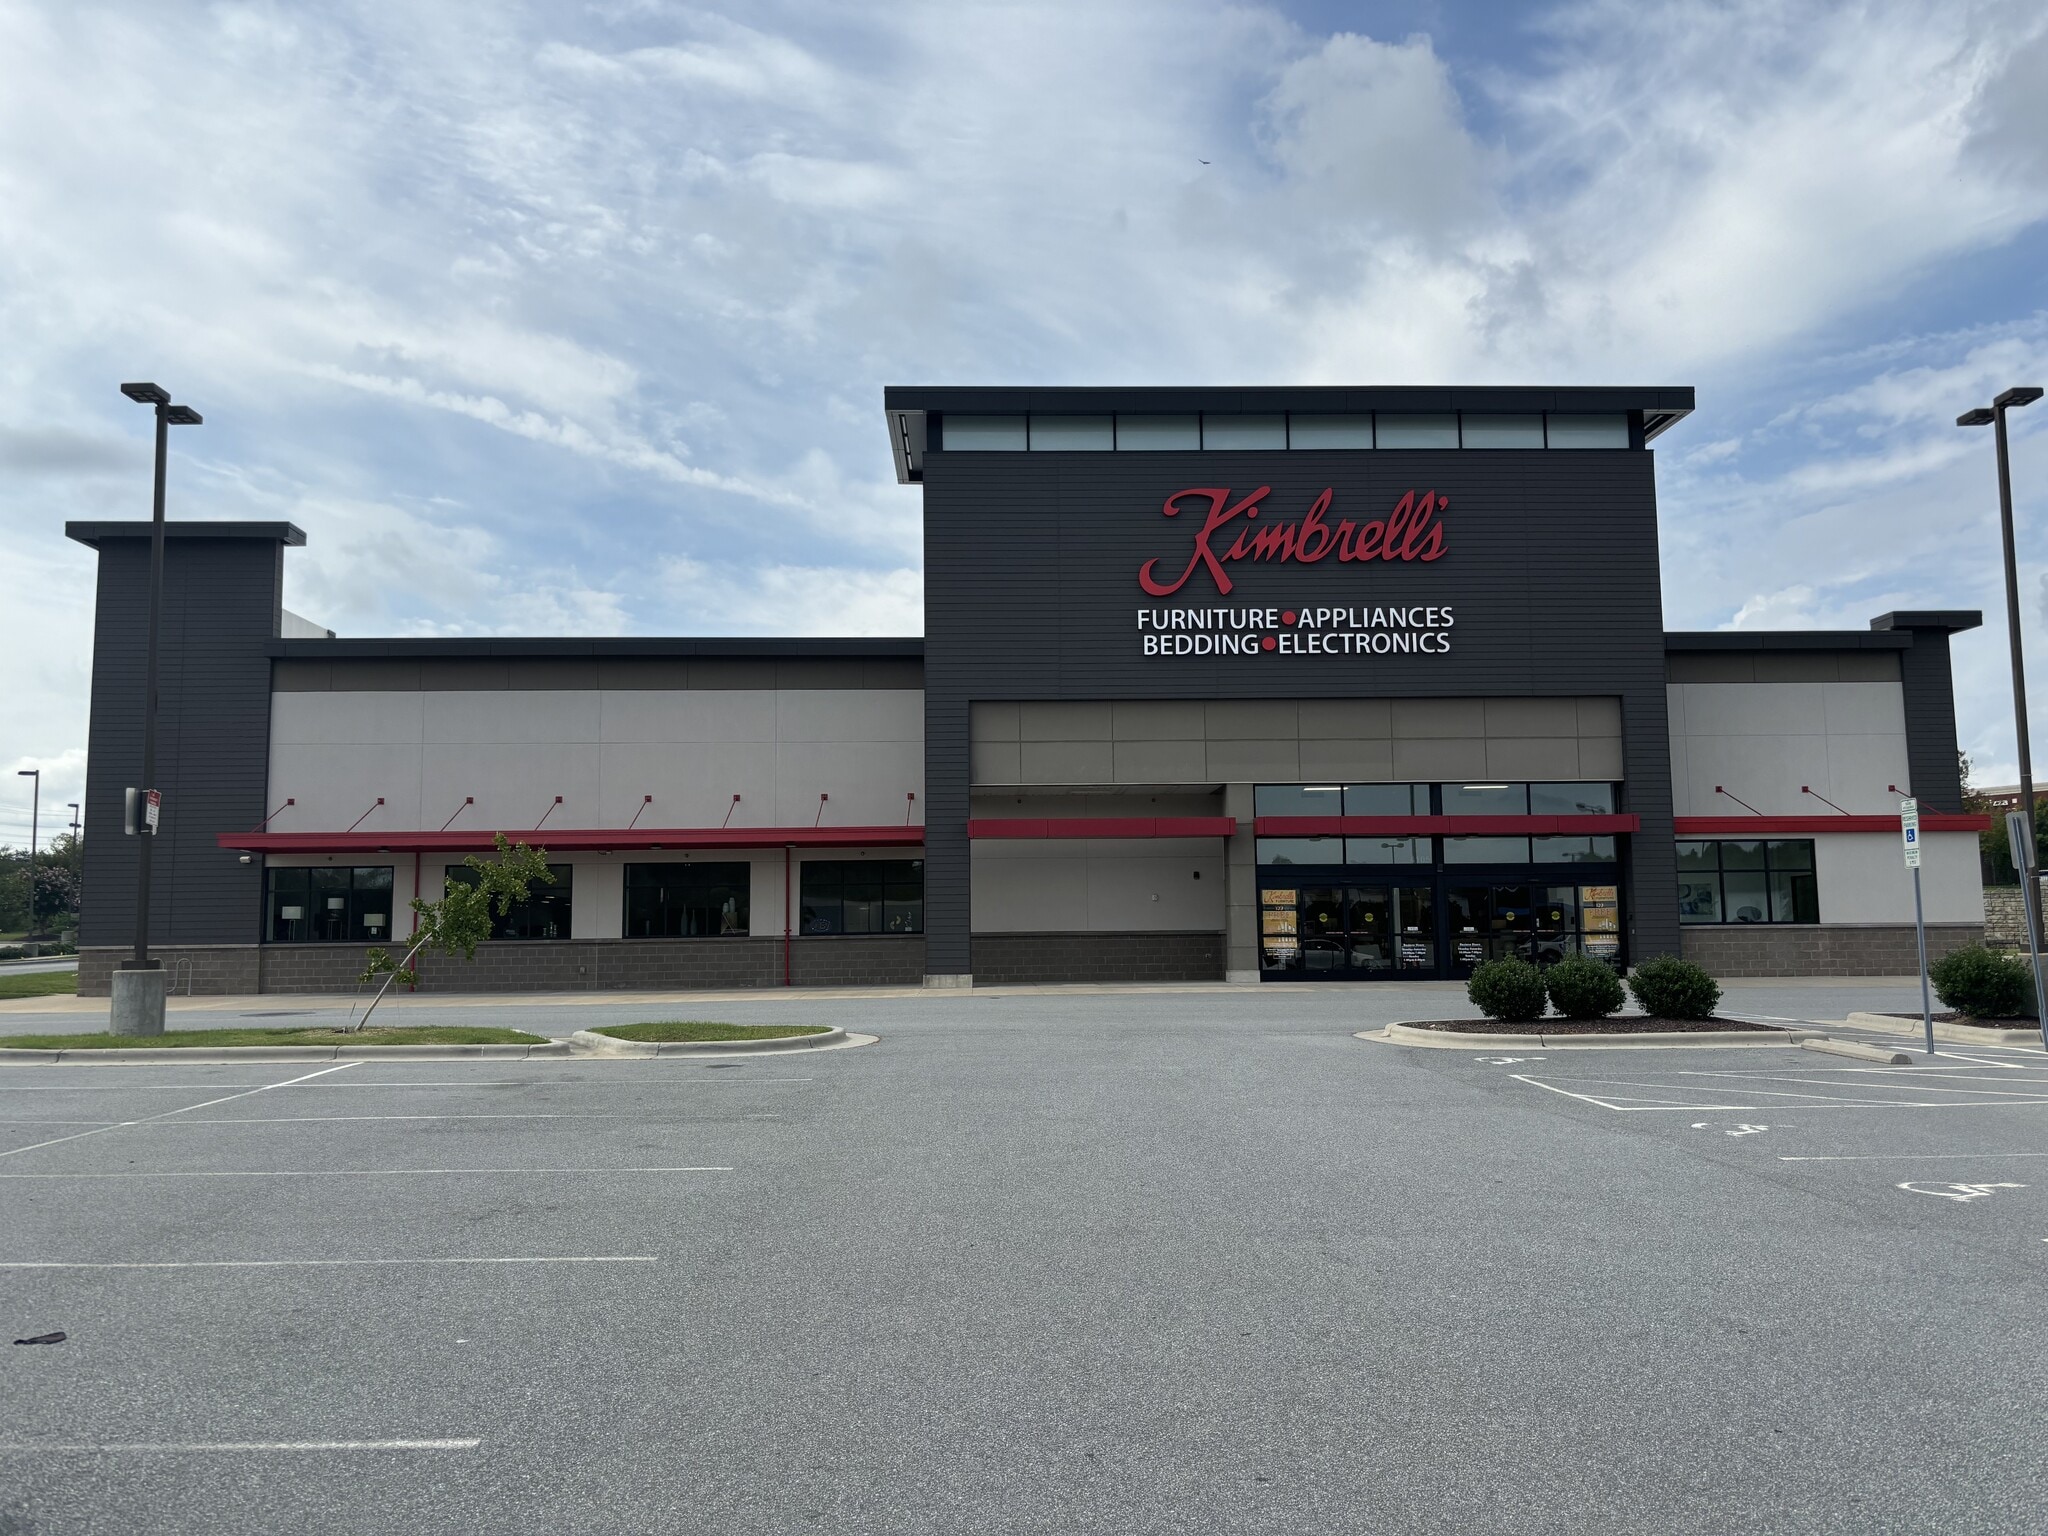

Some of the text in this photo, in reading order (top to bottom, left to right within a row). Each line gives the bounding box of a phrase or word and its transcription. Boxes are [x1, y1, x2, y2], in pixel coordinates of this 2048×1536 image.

[1138, 485, 1449, 596] Kimbrell's
[1137, 606, 1454, 630] FURNITURE APPLIANCES
[1143, 632, 1451, 656] BEDDING ELECTRONICS
